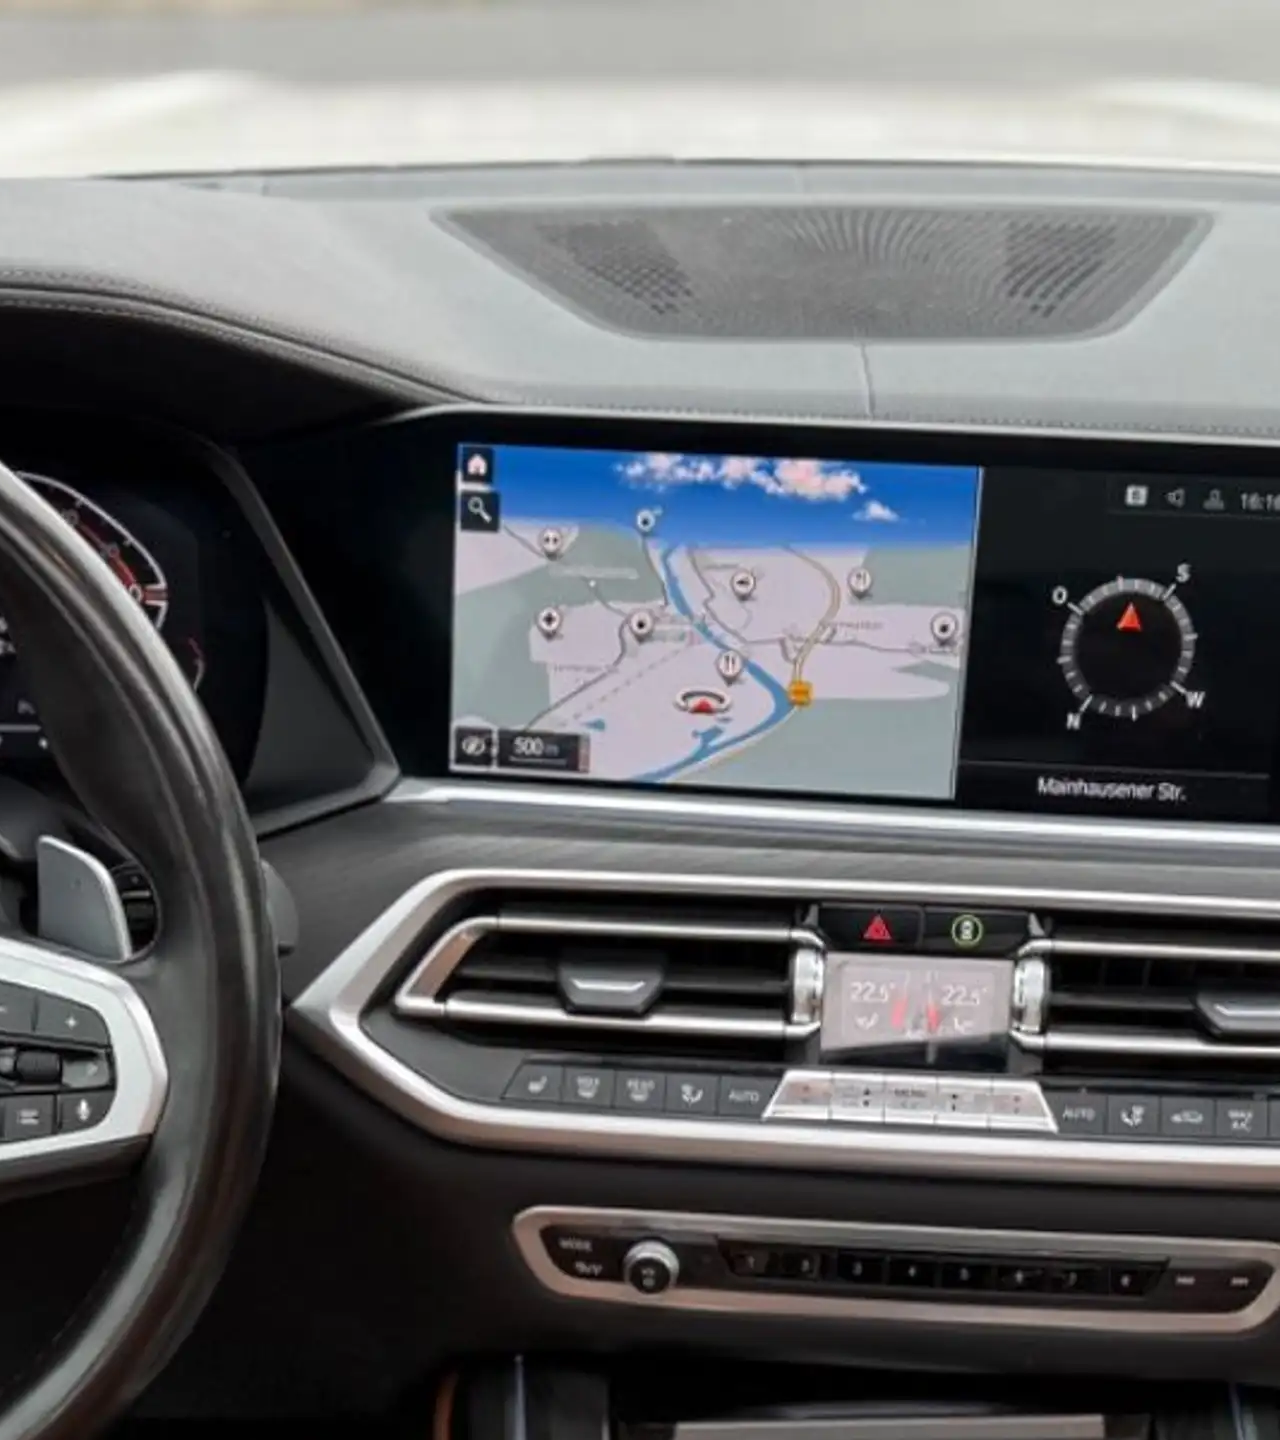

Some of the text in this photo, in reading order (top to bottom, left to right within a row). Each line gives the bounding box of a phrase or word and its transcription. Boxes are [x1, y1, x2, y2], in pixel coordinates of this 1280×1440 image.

[1176, 563, 1192, 584] S
[1187, 691, 1206, 709] W
[1066, 712, 1082, 730] N
[513, 736, 544, 756] 500
[1038, 776, 1187, 801] Mainhausener Str.
